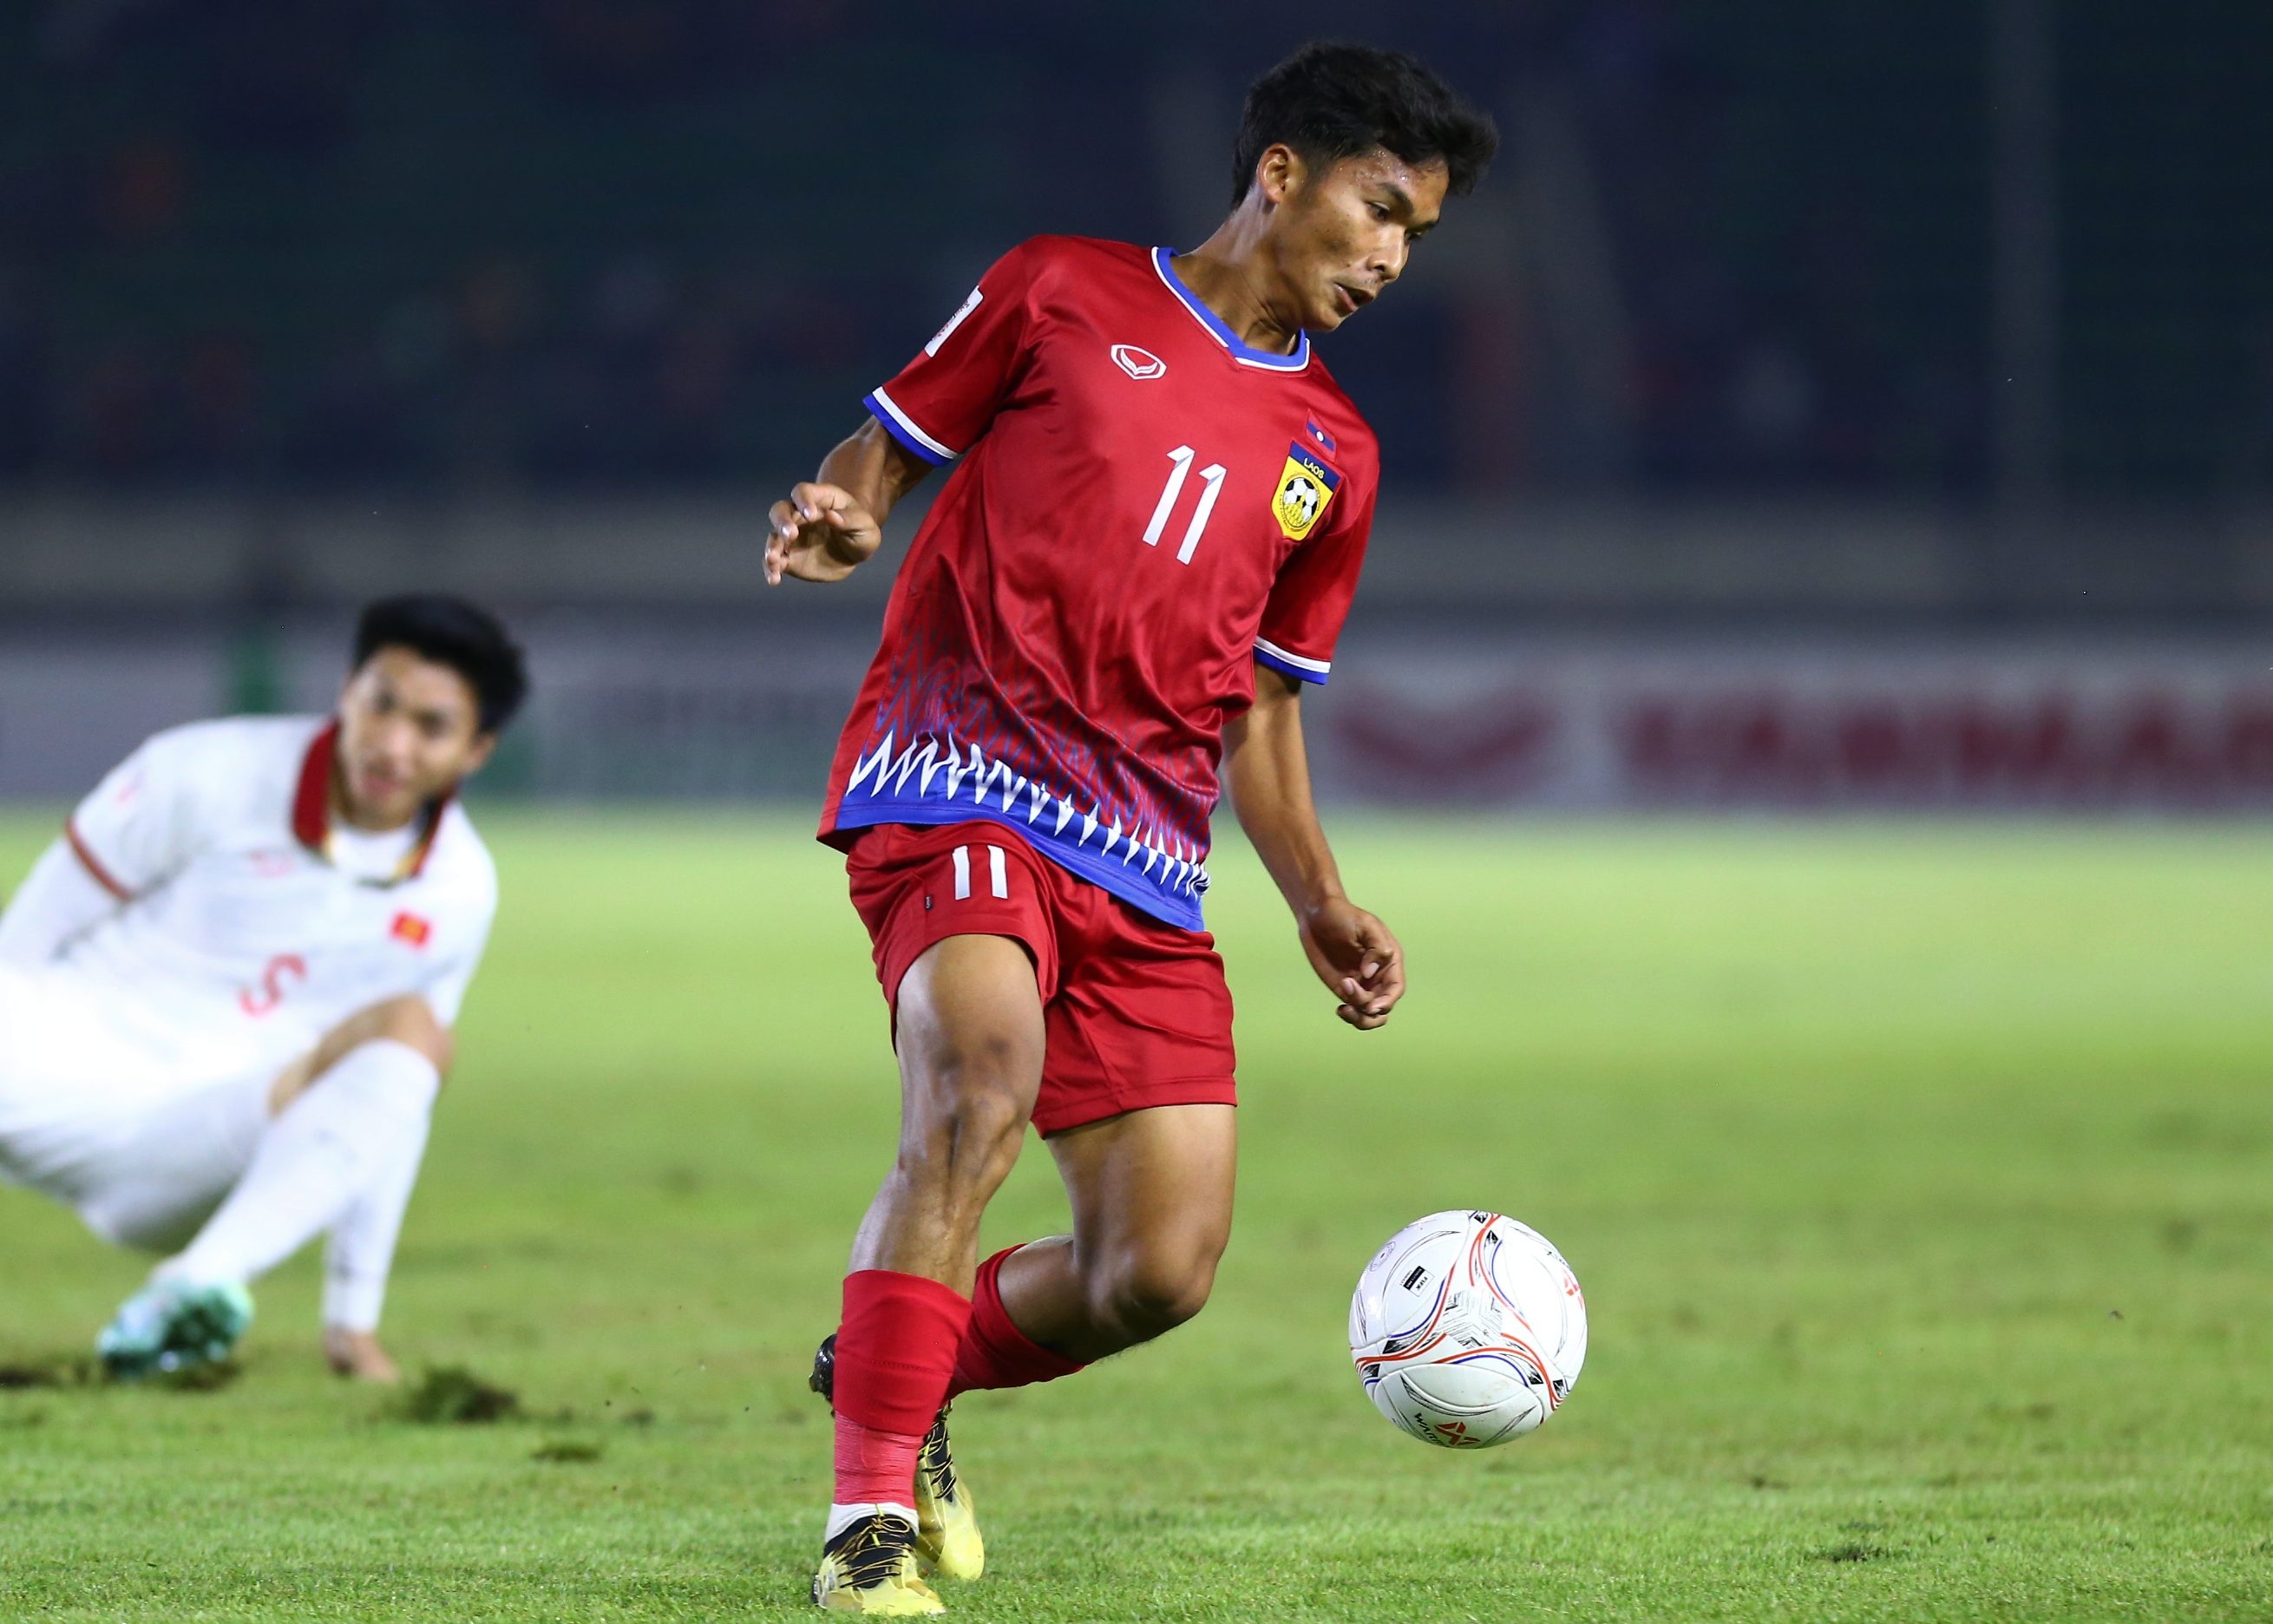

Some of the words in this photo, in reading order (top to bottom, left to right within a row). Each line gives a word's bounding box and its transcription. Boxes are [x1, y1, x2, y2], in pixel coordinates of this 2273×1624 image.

[1303, 457, 1325, 480] LAOS
[1142, 444, 1228, 566] 11
[952, 844, 1009, 901] 11
